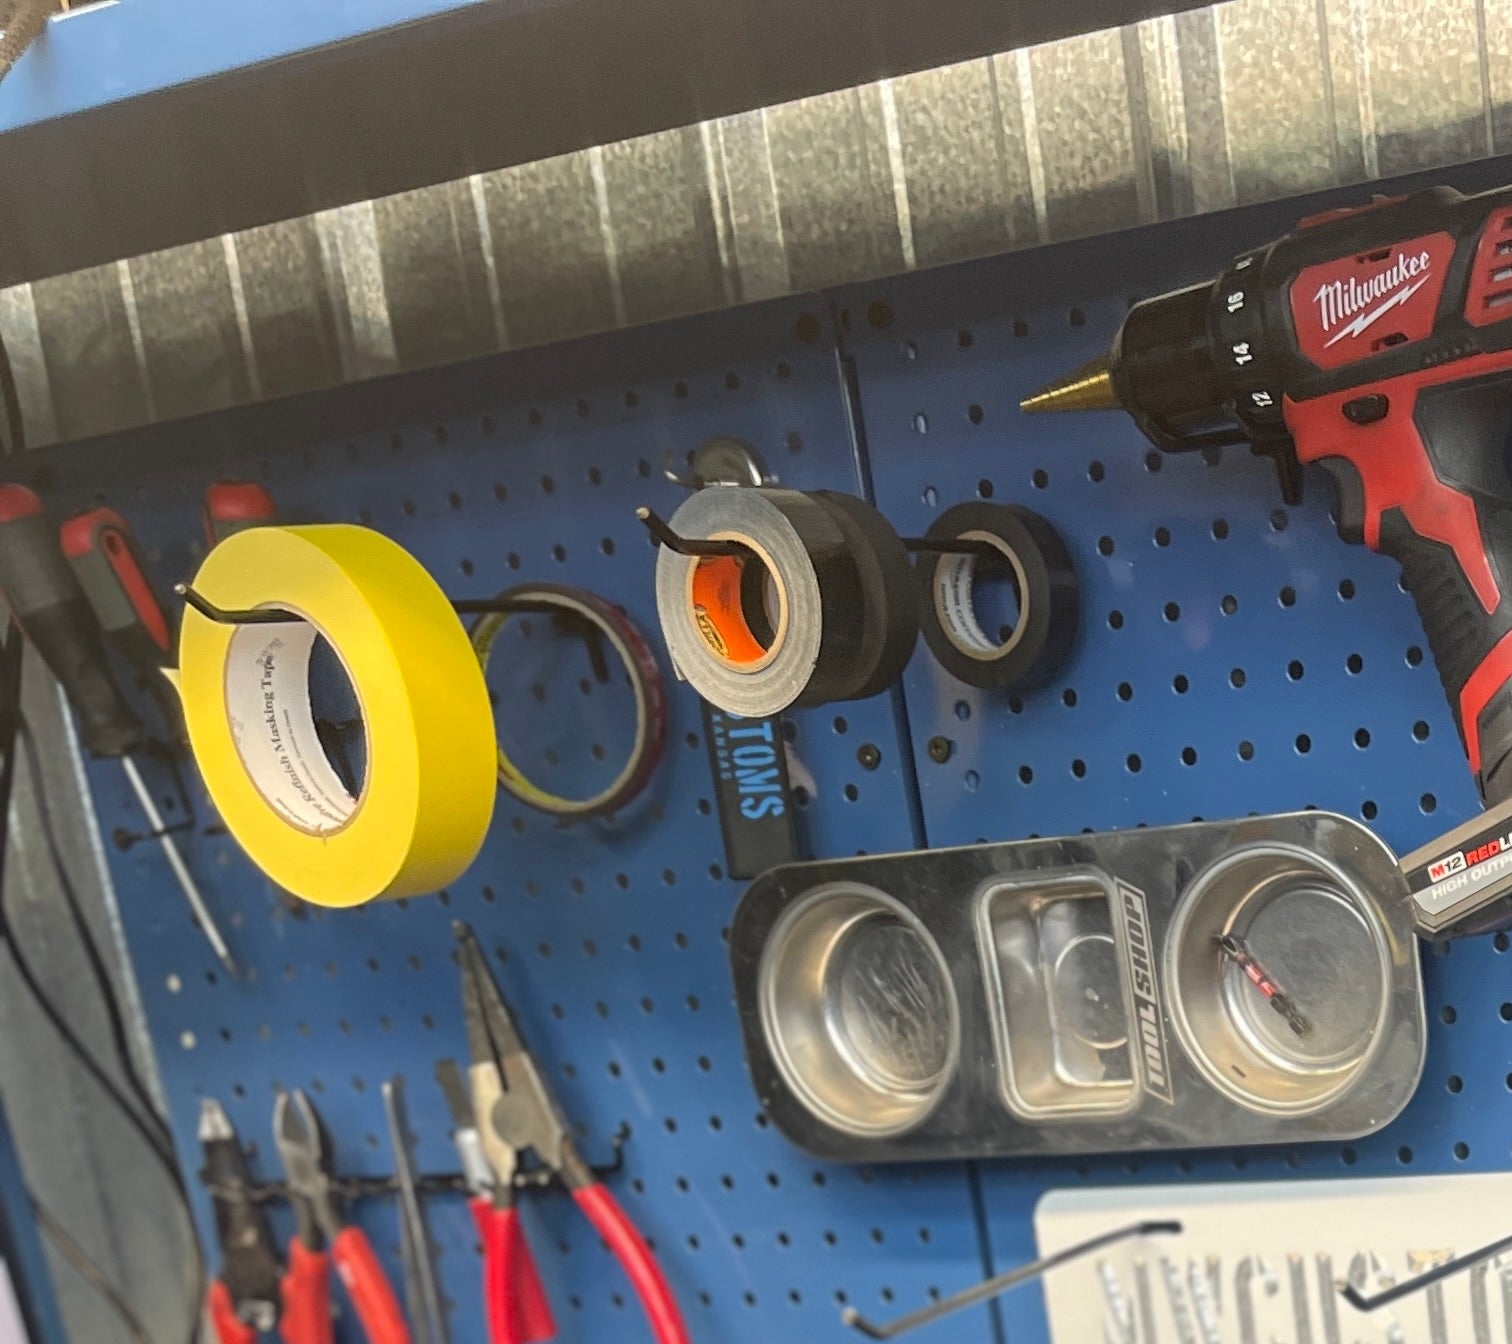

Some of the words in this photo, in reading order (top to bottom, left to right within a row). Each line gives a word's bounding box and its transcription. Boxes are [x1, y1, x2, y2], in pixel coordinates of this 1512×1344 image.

[1227, 291, 1244, 313] 16
[1312, 251, 1430, 332] Milwaukee
[1232, 342, 1253, 365] 14
[726, 711, 785, 820] TOMS
[1430, 853, 1464, 880] M12
[1431, 874, 1468, 901] HIGH
[1123, 894, 1152, 998] SHOP
[1140, 1003, 1165, 1087] TOOL
